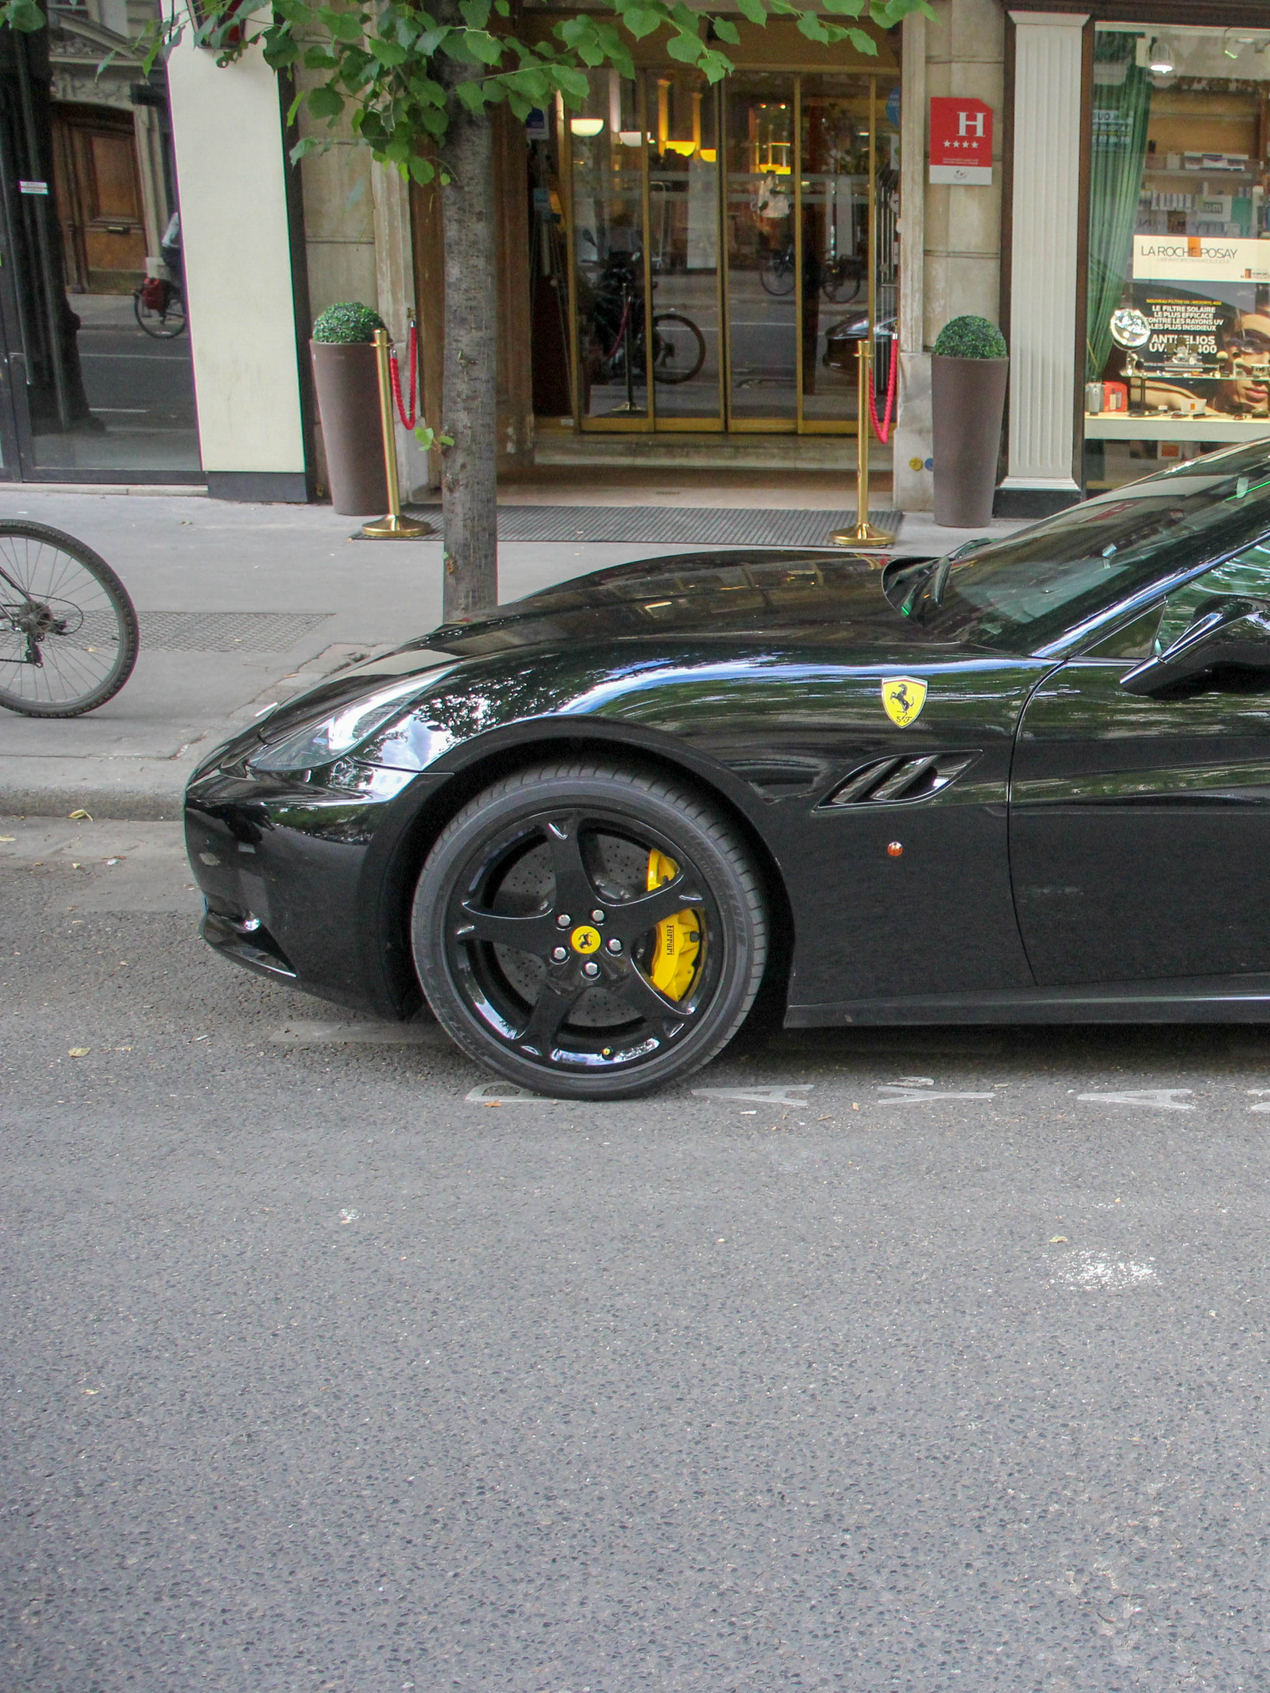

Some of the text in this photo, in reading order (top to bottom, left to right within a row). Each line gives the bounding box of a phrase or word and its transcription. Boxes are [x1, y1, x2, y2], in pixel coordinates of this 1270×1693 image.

[956, 111, 986, 137] H
[1140, 245, 1156, 256] LA
[1201, 248, 1238, 259] POSAY
[666, 925, 675, 956] Ferrari
